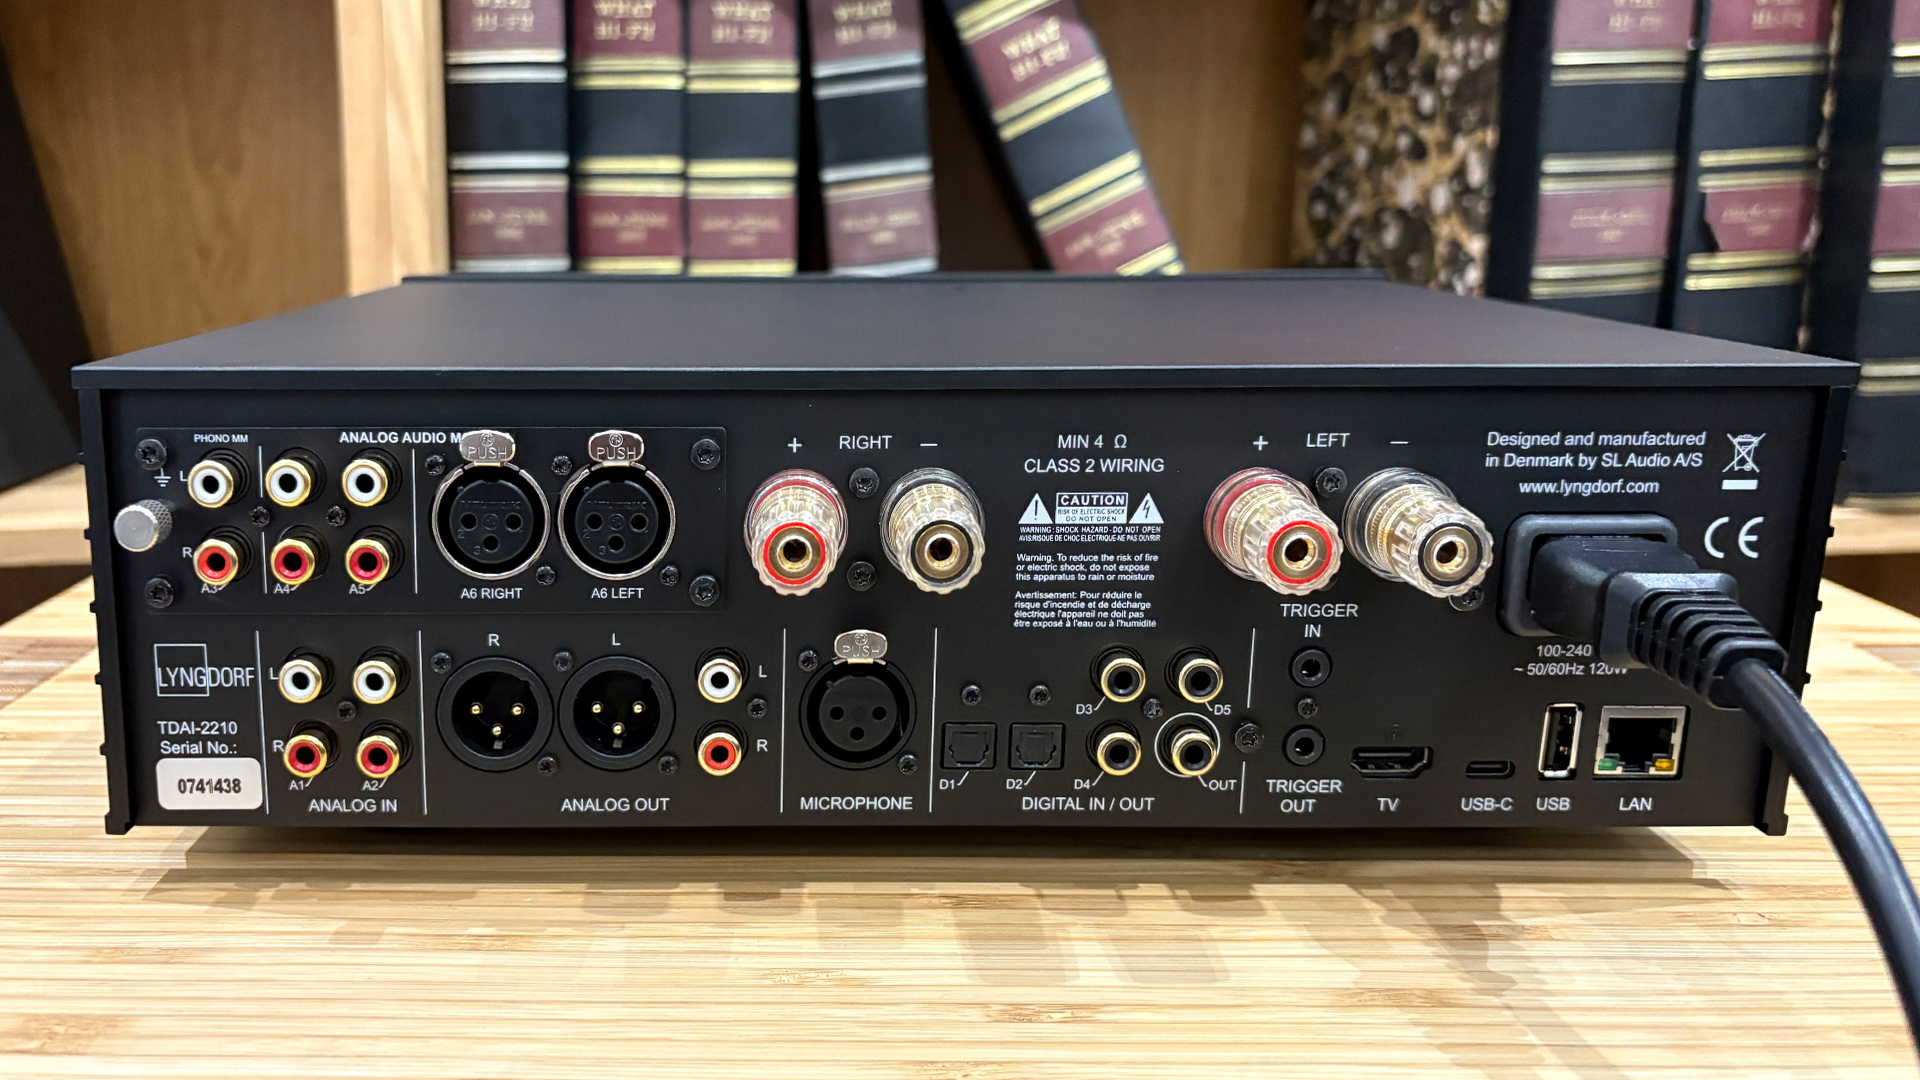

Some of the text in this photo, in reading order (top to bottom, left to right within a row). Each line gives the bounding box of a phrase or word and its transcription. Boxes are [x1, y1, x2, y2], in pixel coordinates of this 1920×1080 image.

[194, 434, 249, 443] PHONO MM
[339, 432, 399, 444] ANALOG
[402, 432, 446, 444] AUDIO
[839, 436, 893, 449] RIGHT
[1058, 434, 1127, 449] MIN 4 Ω
[1306, 433, 1350, 447] LEFT
[1487, 431, 1707, 448] Designed and manufactured
[467, 447, 507, 459] PUSH
[596, 447, 636, 459] PUSH
[1024, 458, 1164, 473] CLASS 2 WIRING
[1486, 453, 1704, 469] in Denmark by SL Audio A/S
[180, 471, 188, 482] L
[1519, 479, 1660, 496] www.lyngdorf.com
[1060, 495, 1125, 505] CAUTION
[183, 547, 192, 559] R
[1057, 553, 1067, 562] To
[1069, 553, 1099, 562] reduce
[1101, 553, 1114, 562] the
[1116, 553, 1132, 562] risk
[1134, 553, 1143, 562] of
[1145, 553, 1159, 562] fire
[1027, 563, 1058, 572] electric
[1089, 563, 1101, 572] do
[1103, 563, 1117, 572] not
[1119, 565, 1150, 573] expose
[1016, 573, 1031, 581] this
[1033, 573, 1075, 582] apparatus
[1077, 573, 1086, 581] to
[1088, 573, 1105, 581] rain
[1117, 573, 1155, 581] moisture
[274, 584, 290, 594] A4
[349, 584, 366, 594] A5
[461, 588, 523, 599] A6 RIGHT
[591, 588, 644, 599] A6 LEFT
[1015, 591, 1142, 599] Avertissement: Pour réduire le
[1014, 601, 1151, 610] risque d'incendie et de décharge
[1280, 604, 1358, 617] TRIGGER
[1014, 610, 1055, 618] électrique
[1057, 610, 1096, 618] l'appareil
[1110, 610, 1126, 618] doit
[1013, 620, 1030, 628] être
[1032, 620, 1063, 629] exposé
[1065, 619, 1071, 628] à
[1073, 620, 1093, 628] l'eau
[1109, 620, 1115, 628] à
[1116, 620, 1157, 628] l'humidité
[1304, 625, 1321, 638] IN
[489, 634, 500, 646] R
[612, 634, 621, 646] L
[842, 645, 879, 657] PUSH
[1536, 644, 1592, 657] 100-240
[270, 668, 279, 680] L
[758, 665, 767, 678] L
[1527, 663, 1585, 676] 50/60Hz
[157, 667, 255, 688] LYNGDORF
[1076, 705, 1092, 715] D3
[1214, 705, 1231, 715] D5
[157, 721, 238, 735] TDAI-2210
[161, 742, 237, 755] Serial No.:
[273, 740, 284, 753] R
[757, 739, 768, 752] R
[178, 779, 242, 794] 0741438
[290, 781, 305, 791] A1
[363, 781, 379, 791] A2
[940, 780, 955, 790] D1
[1006, 780, 1023, 790] D2
[1074, 780, 1091, 790] D4
[1209, 780, 1237, 791] OUT
[1266, 780, 1343, 793] TRIGGER
[309, 799, 398, 812] ANALOG IN
[561, 798, 670, 811] ANALOG OUT
[800, 797, 913, 811] MICROPHONE
[1022, 797, 1084, 811] DIGITAL
[1089, 797, 1105, 811] IN
[1119, 797, 1155, 811] OUT
[1280, 800, 1316, 813] OUT
[1377, 797, 1399, 811] TV
[1461, 797, 1514, 811] USB-C
[1536, 797, 1571, 811] USB
[1619, 797, 1652, 811] LAN
